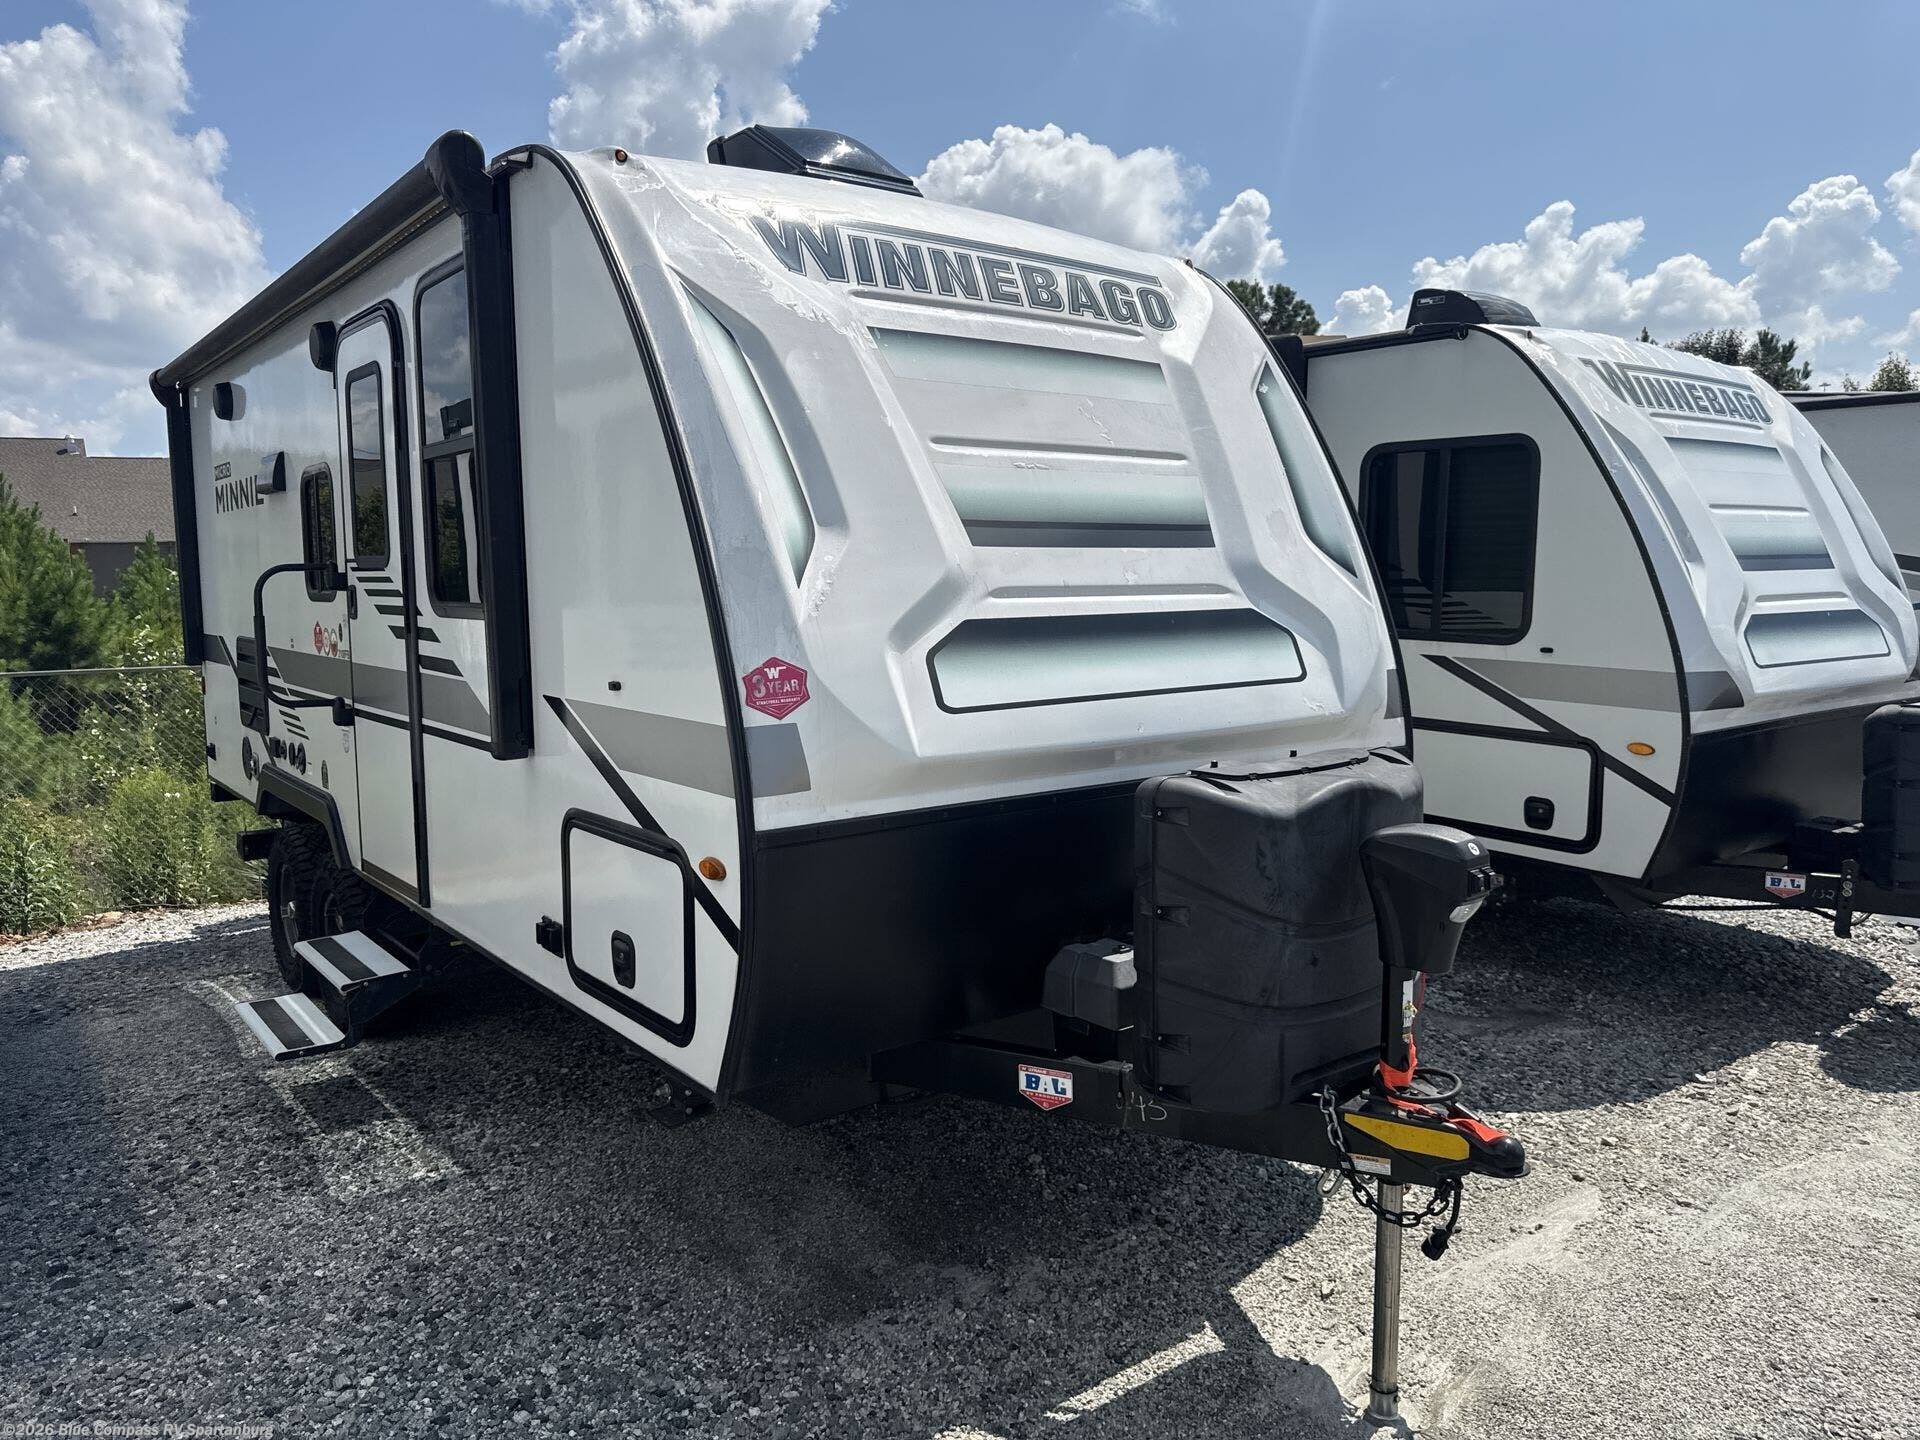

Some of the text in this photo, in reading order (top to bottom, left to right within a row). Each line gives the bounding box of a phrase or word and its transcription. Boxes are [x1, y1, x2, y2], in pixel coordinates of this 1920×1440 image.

[749, 213, 1178, 331] WINNEBAGO
[1578, 357, 1774, 424] WINNEBAGO
[752, 675, 799, 698] 3 YEAR
